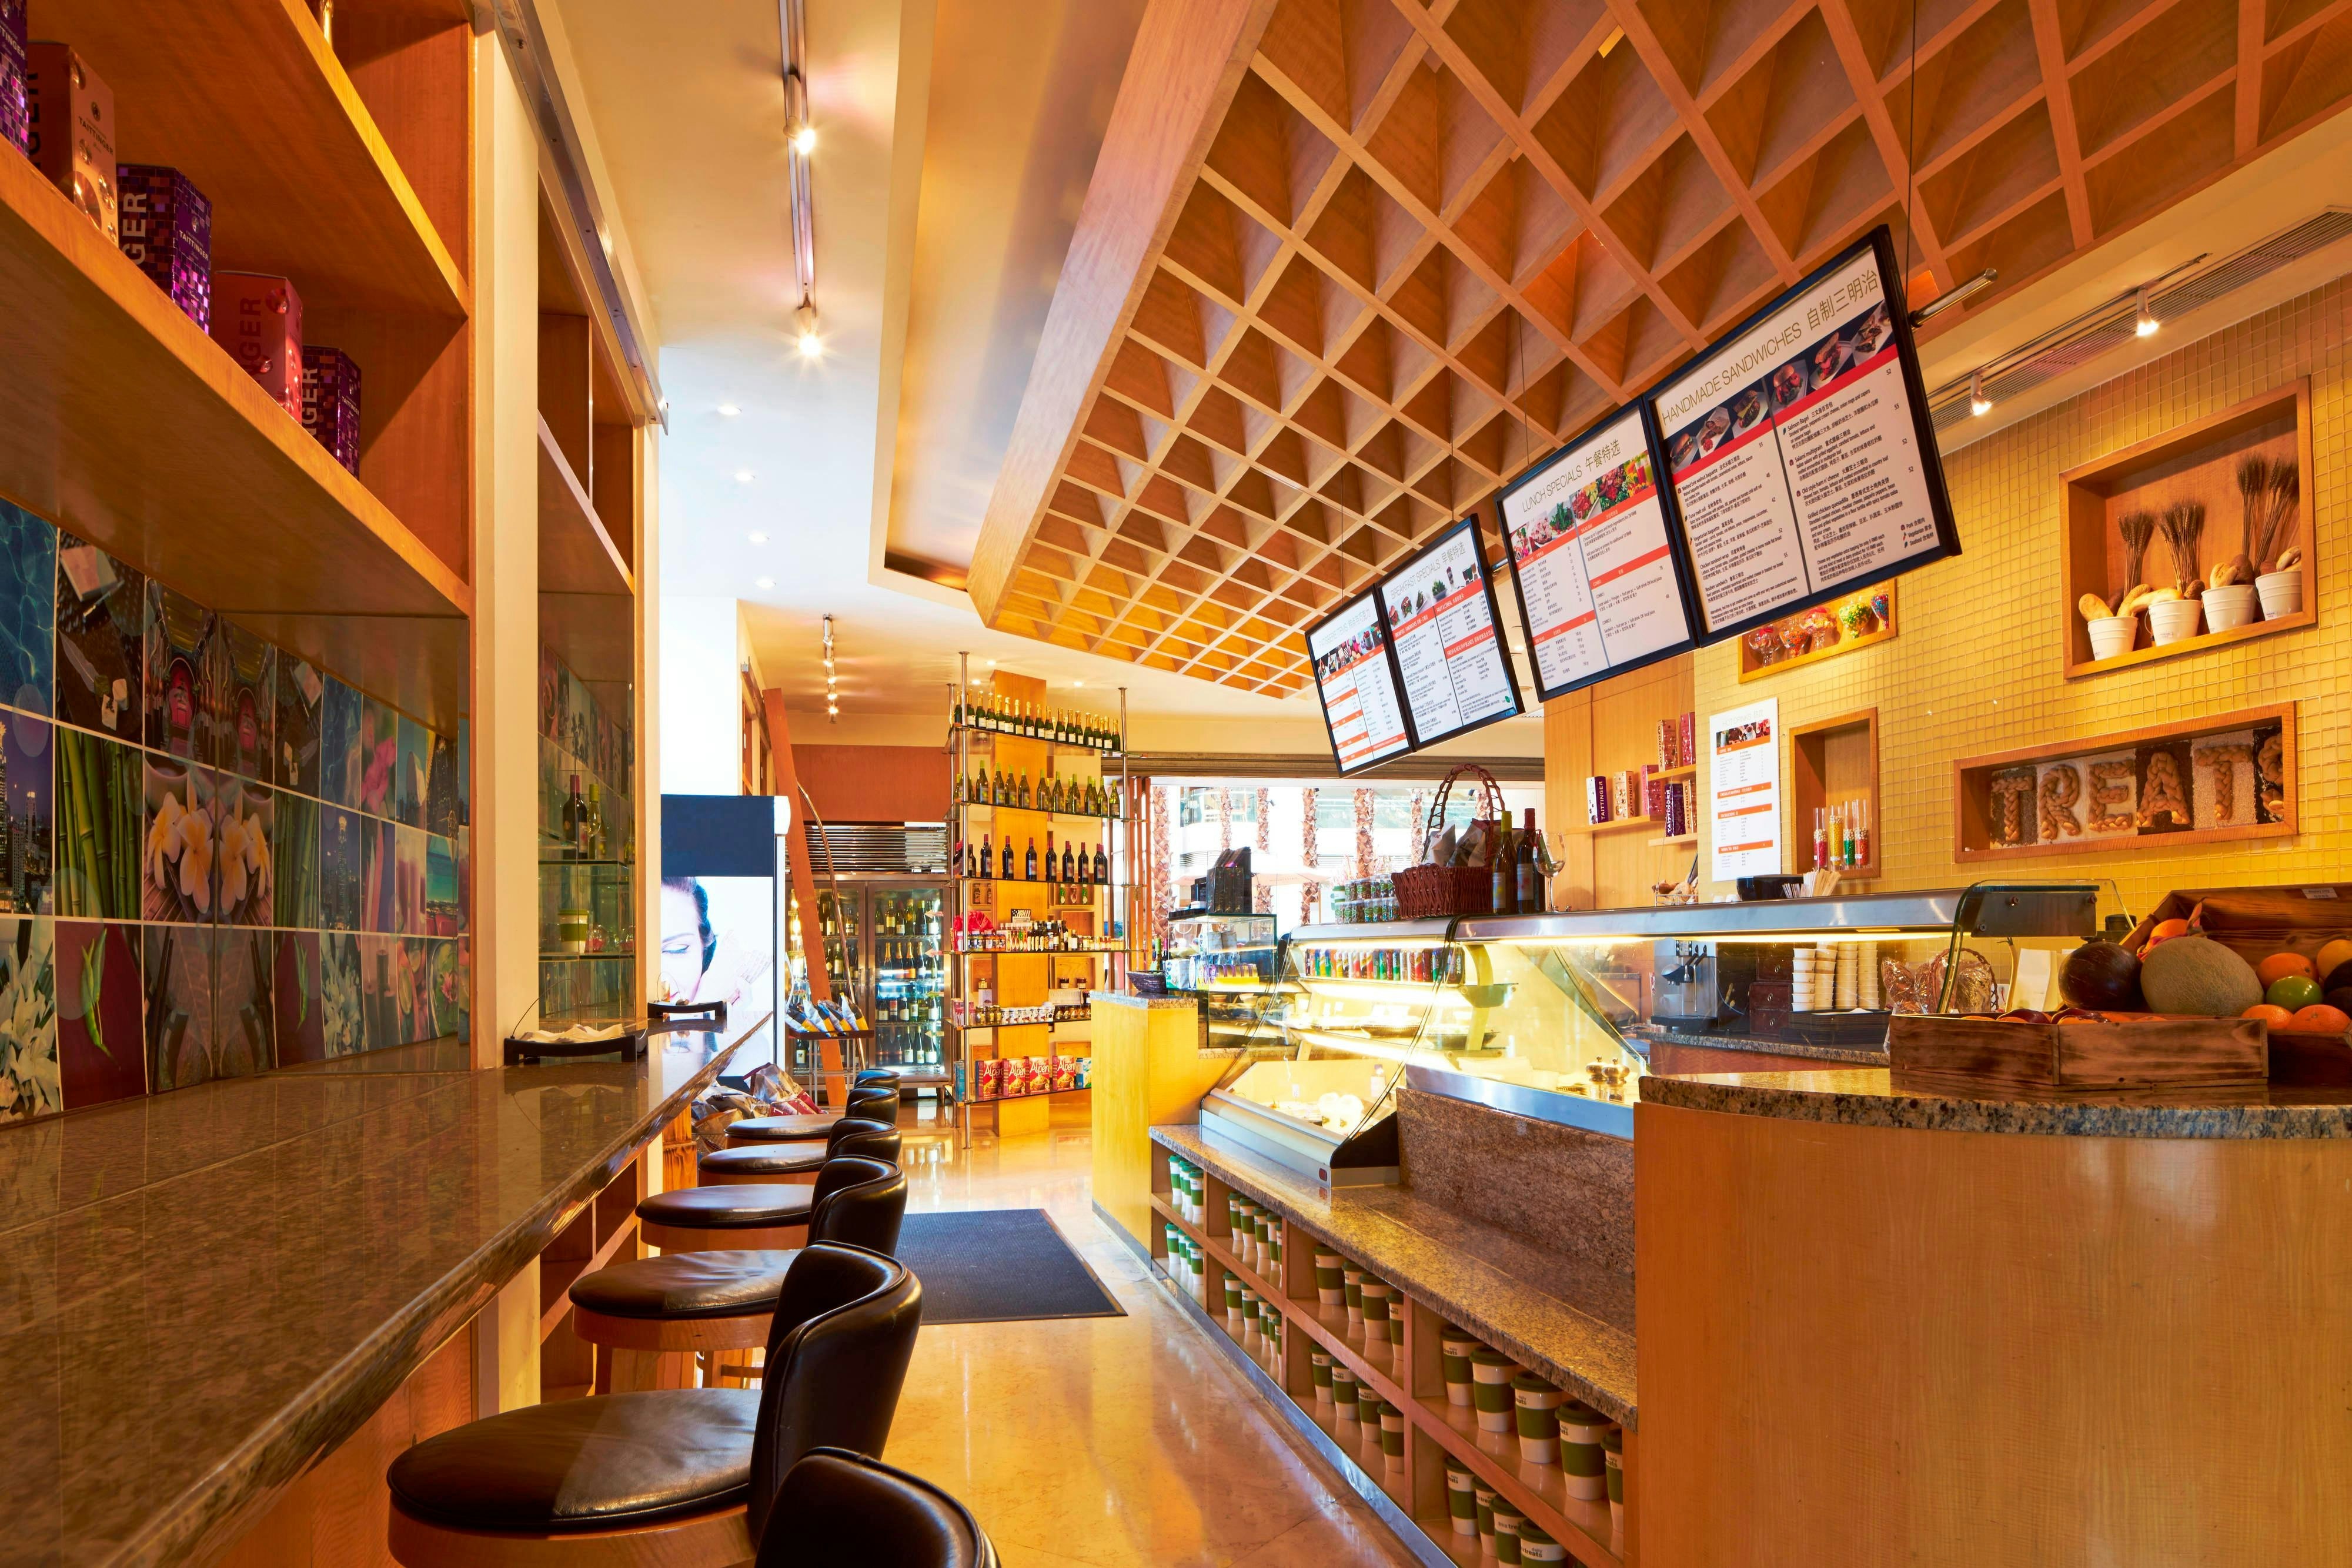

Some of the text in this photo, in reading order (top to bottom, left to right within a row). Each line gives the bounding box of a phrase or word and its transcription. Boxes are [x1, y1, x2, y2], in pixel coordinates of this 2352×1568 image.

[0, 25, 25, 59] TINGER
[78, 116, 113, 155] TAITTINGER
[179, 229, 209, 261] TAITTINGER
[1662, 270, 1878, 426] HANDMADE SANDWICHES 自制三明治
[341, 395, 360, 415] TAITTINGER
[1787, 421, 1800, 432] Salmon
[1799, 414, 1809, 424] Bagel
[1795, 453, 1806, 463] Salami
[1522, 439, 1621, 513] LUNCH SPECIALS 午餐特选
[1827, 473, 1839, 482] cheese
[1808, 510, 1819, 519] Grilled
[1818, 505, 1832, 514] chicken
[1390, 574, 1416, 600] BREAKFAST
[1416, 559, 1441, 582] SPECIALS
[1991, 733, 2284, 842] TREATS
[984, 1065, 1003, 1076] Alpen
[1009, 1064, 1025, 1076] Alpen
[1030, 1061, 1050, 1074] Alpen
[1058, 1060, 1075, 1071] Alpen
[1524, 1549, 1543, 1557] treats
